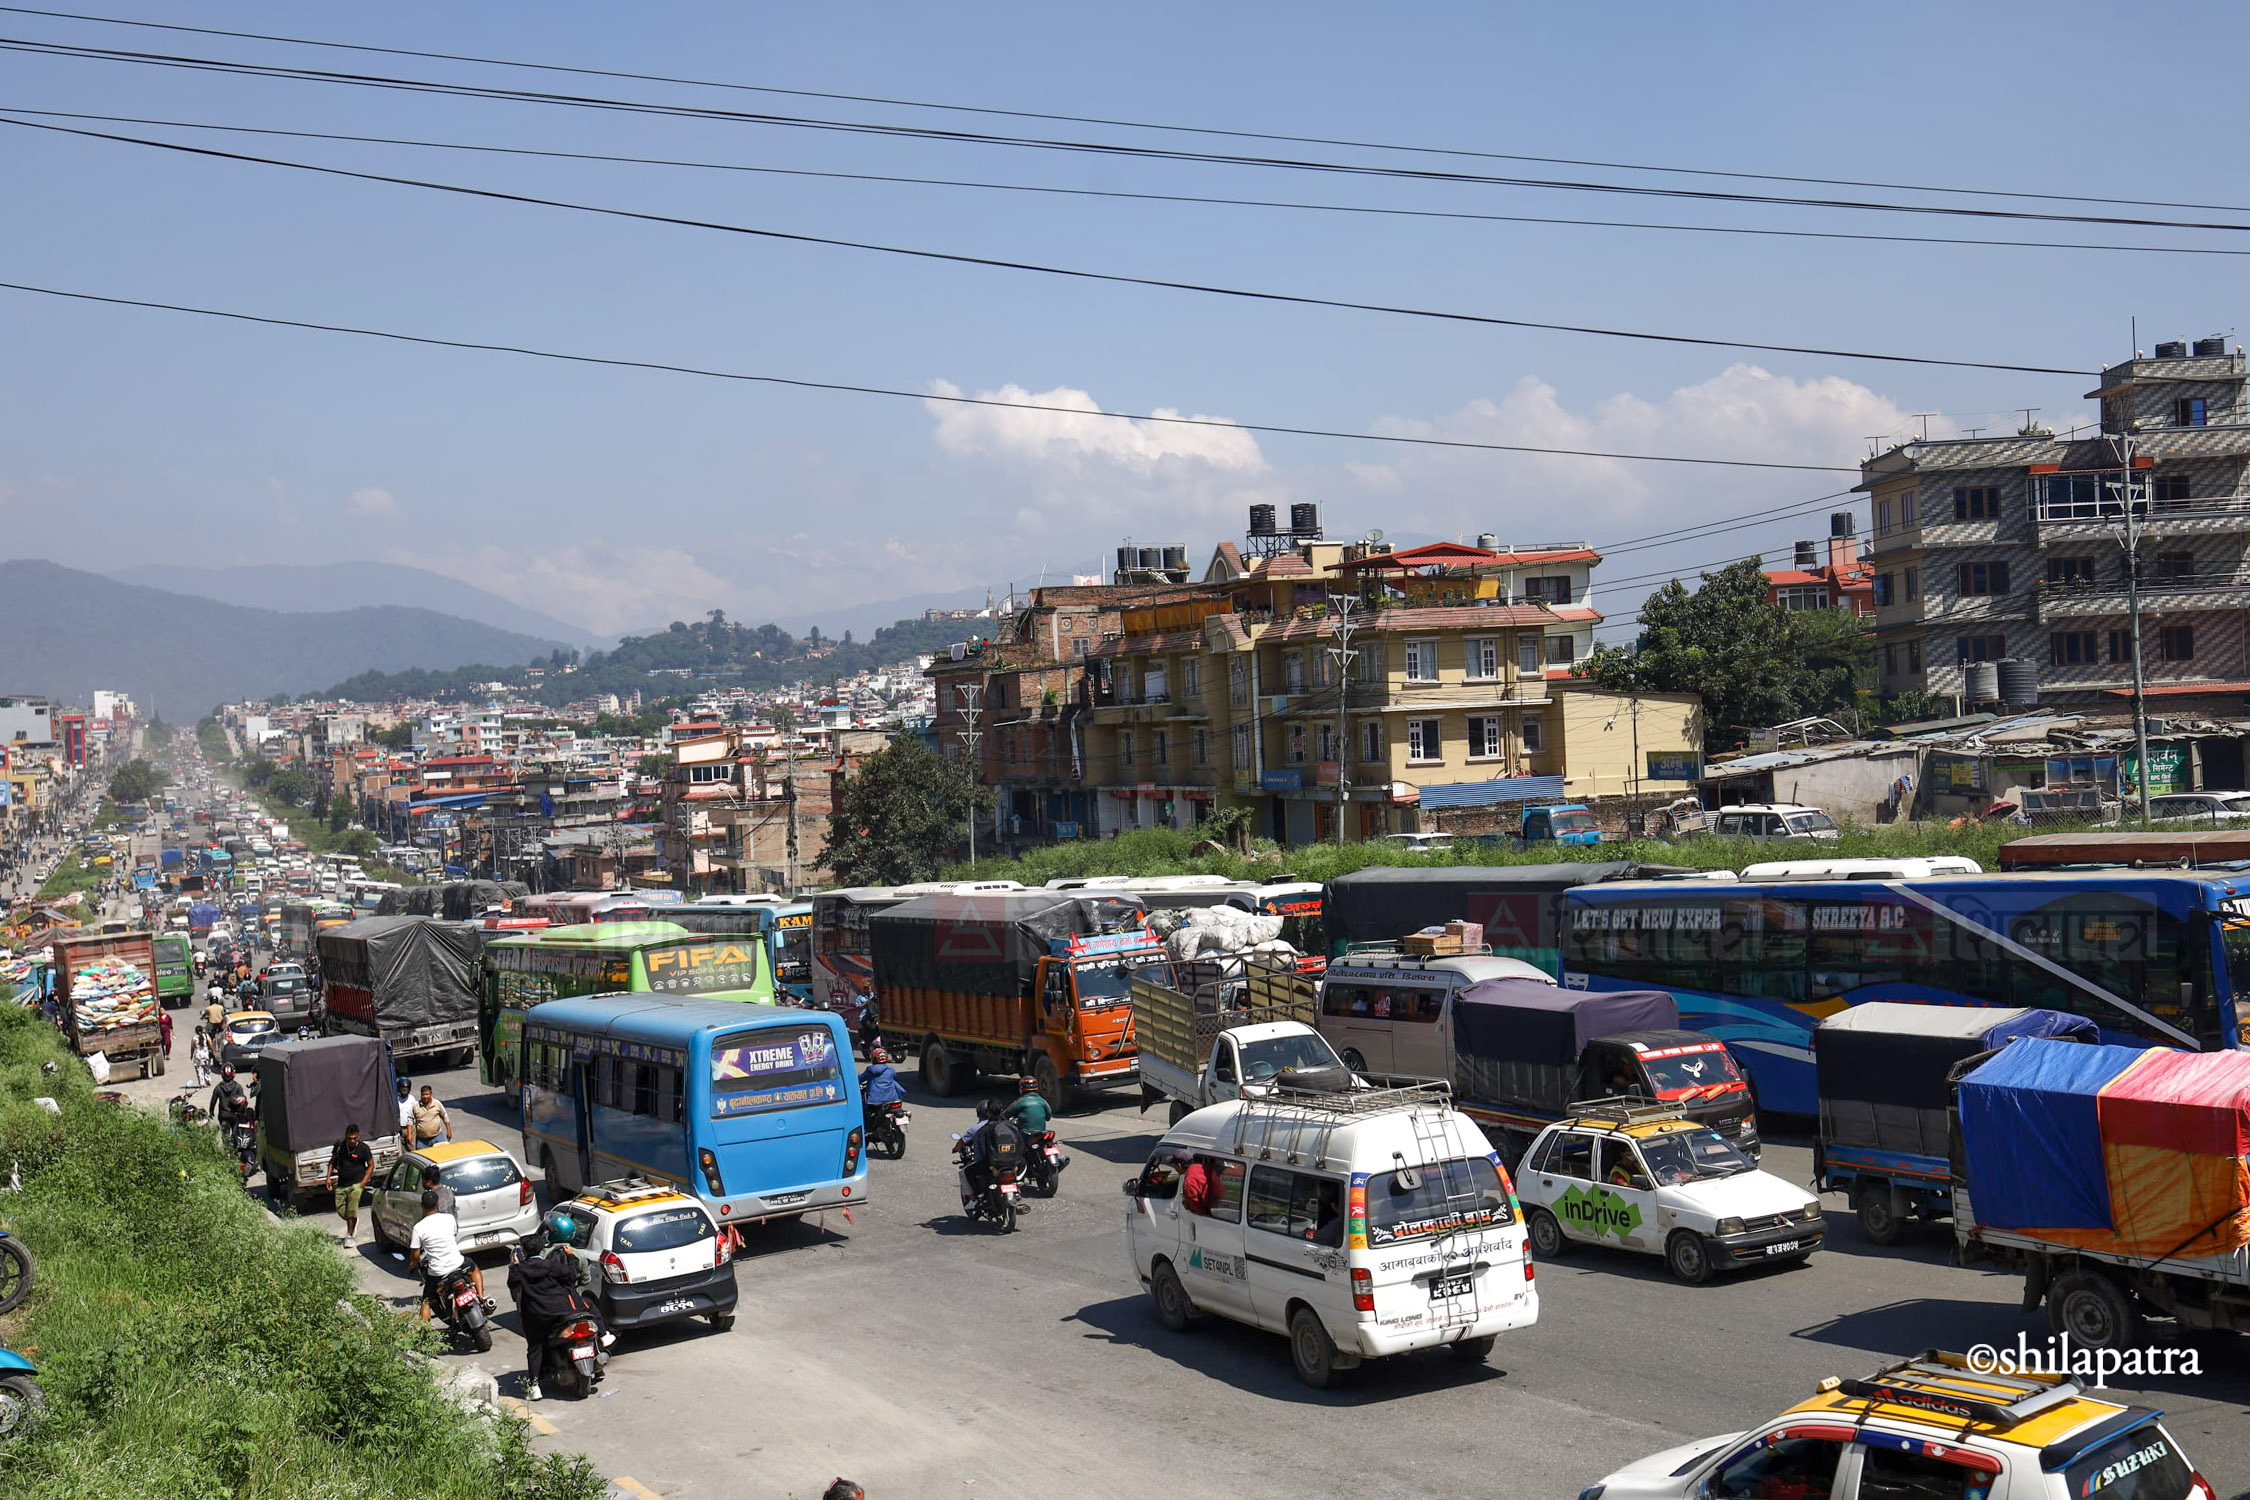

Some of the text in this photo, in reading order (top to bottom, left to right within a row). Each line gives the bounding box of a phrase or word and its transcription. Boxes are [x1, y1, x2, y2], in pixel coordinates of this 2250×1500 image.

[1573, 909, 1608, 930] LET'S
[1612, 909, 1638, 930] GET
[1641, 909, 1673, 930] NEW
[1812, 906, 1876, 929] SHREEYA
[648, 945, 751, 972] FIFA
[688, 968, 715, 976] SOFA
[717, 965, 738, 973] A/C
[749, 1046, 794, 1063] XTREME
[750, 1058, 795, 1072] ENERGY DRINK
[503, 1170, 514, 1183] TAXI
[1564, 1195, 1631, 1228] inDrive
[698, 1223, 707, 1236] TAXI
[619, 1237, 633, 1248] TAXI
[1380, 1313, 1423, 1327] KING LONG
[1899, 1394, 1972, 1417] adidas
[2101, 1440, 2169, 1487] SUZUKI
